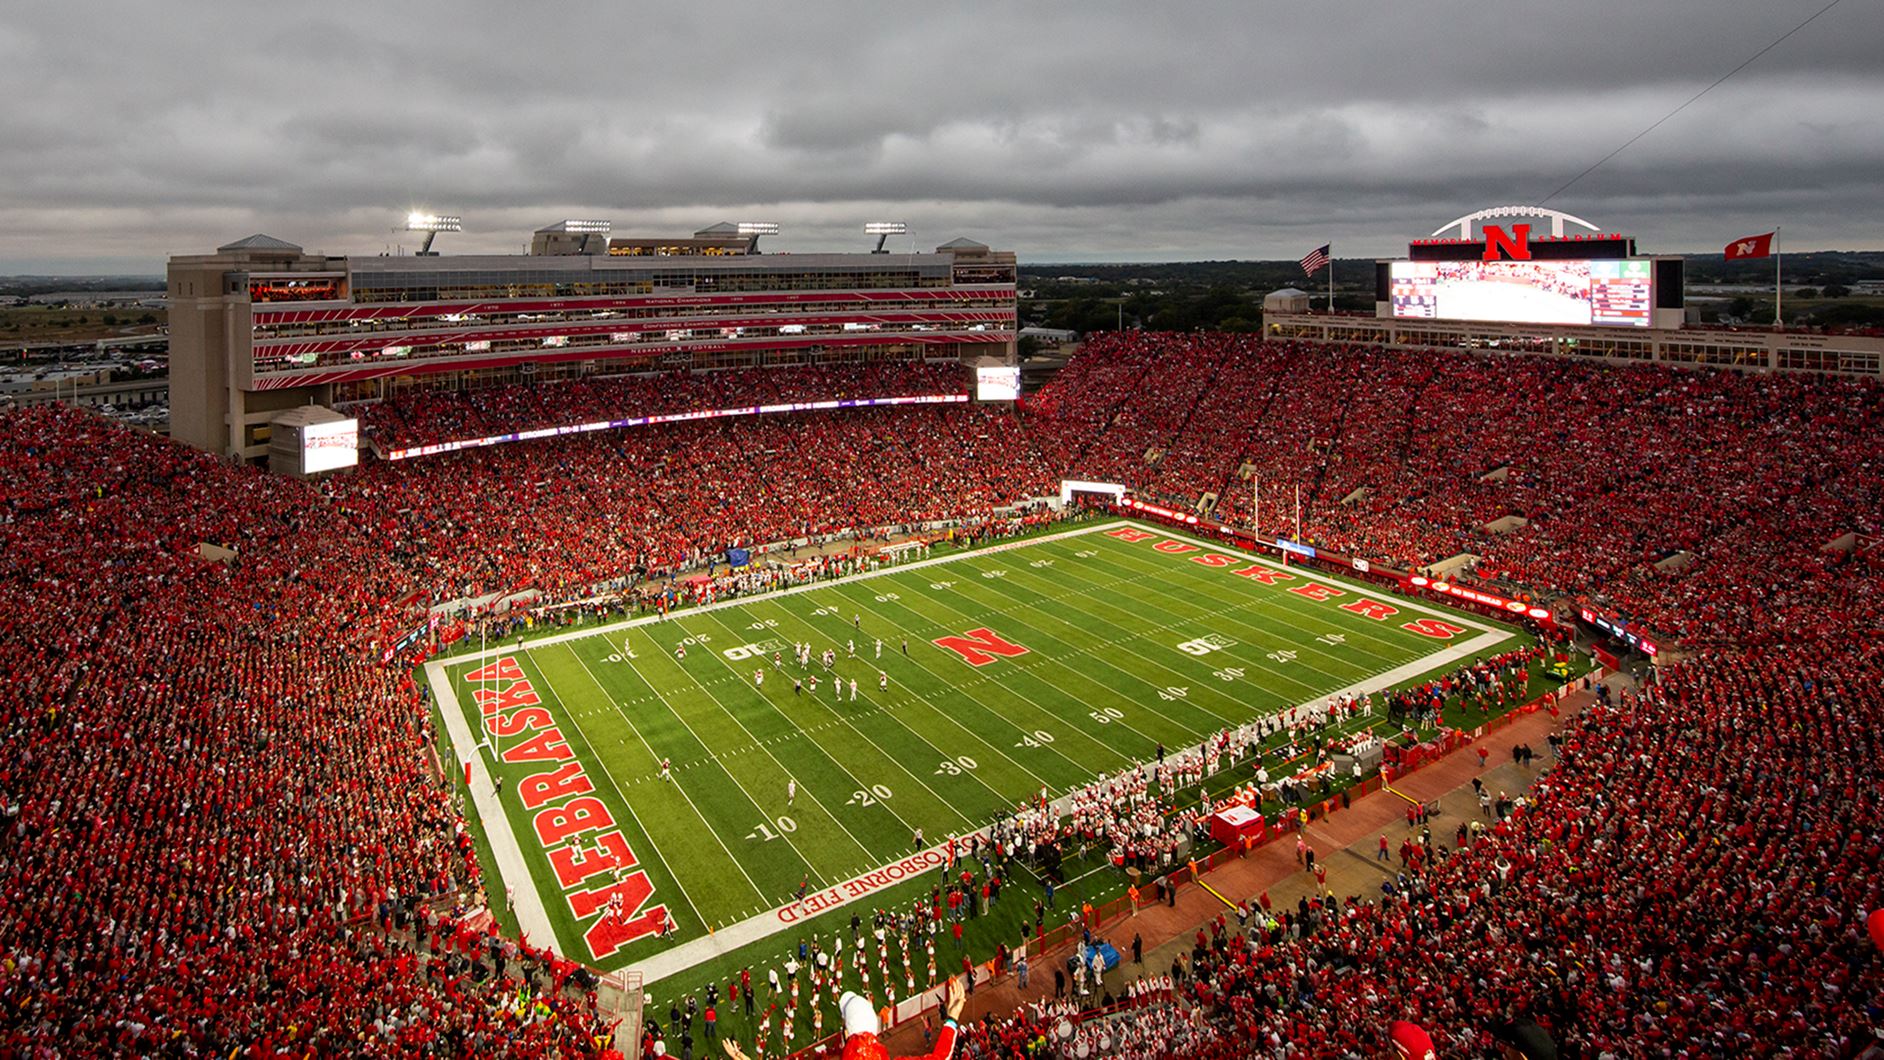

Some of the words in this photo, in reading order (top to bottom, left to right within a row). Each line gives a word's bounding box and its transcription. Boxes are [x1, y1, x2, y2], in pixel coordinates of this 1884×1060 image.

[1413, 238, 1480, 246] MEMORIAL
[1538, 233, 1622, 243] STADIUM
[1482, 224, 1531, 261] N
[1736, 240, 1757, 256] N
[1104, 528, 1466, 639] HUSKERS
[931, 627, 1031, 667] N
[1266, 650, 1297, 663] 20
[1213, 667, 1245, 682] 30
[1157, 686, 1188, 702] 40
[1089, 707, 1125, 725] 50
[1021, 730, 1055, 750] 40
[940, 755, 978, 777] 30
[852, 784, 893, 808] 20
[464, 656, 680, 962] NEBRASKA
[753, 816, 798, 842] 10
[842, 850, 943, 899] OSBORNE
[777, 886, 845, 924] FIELD
